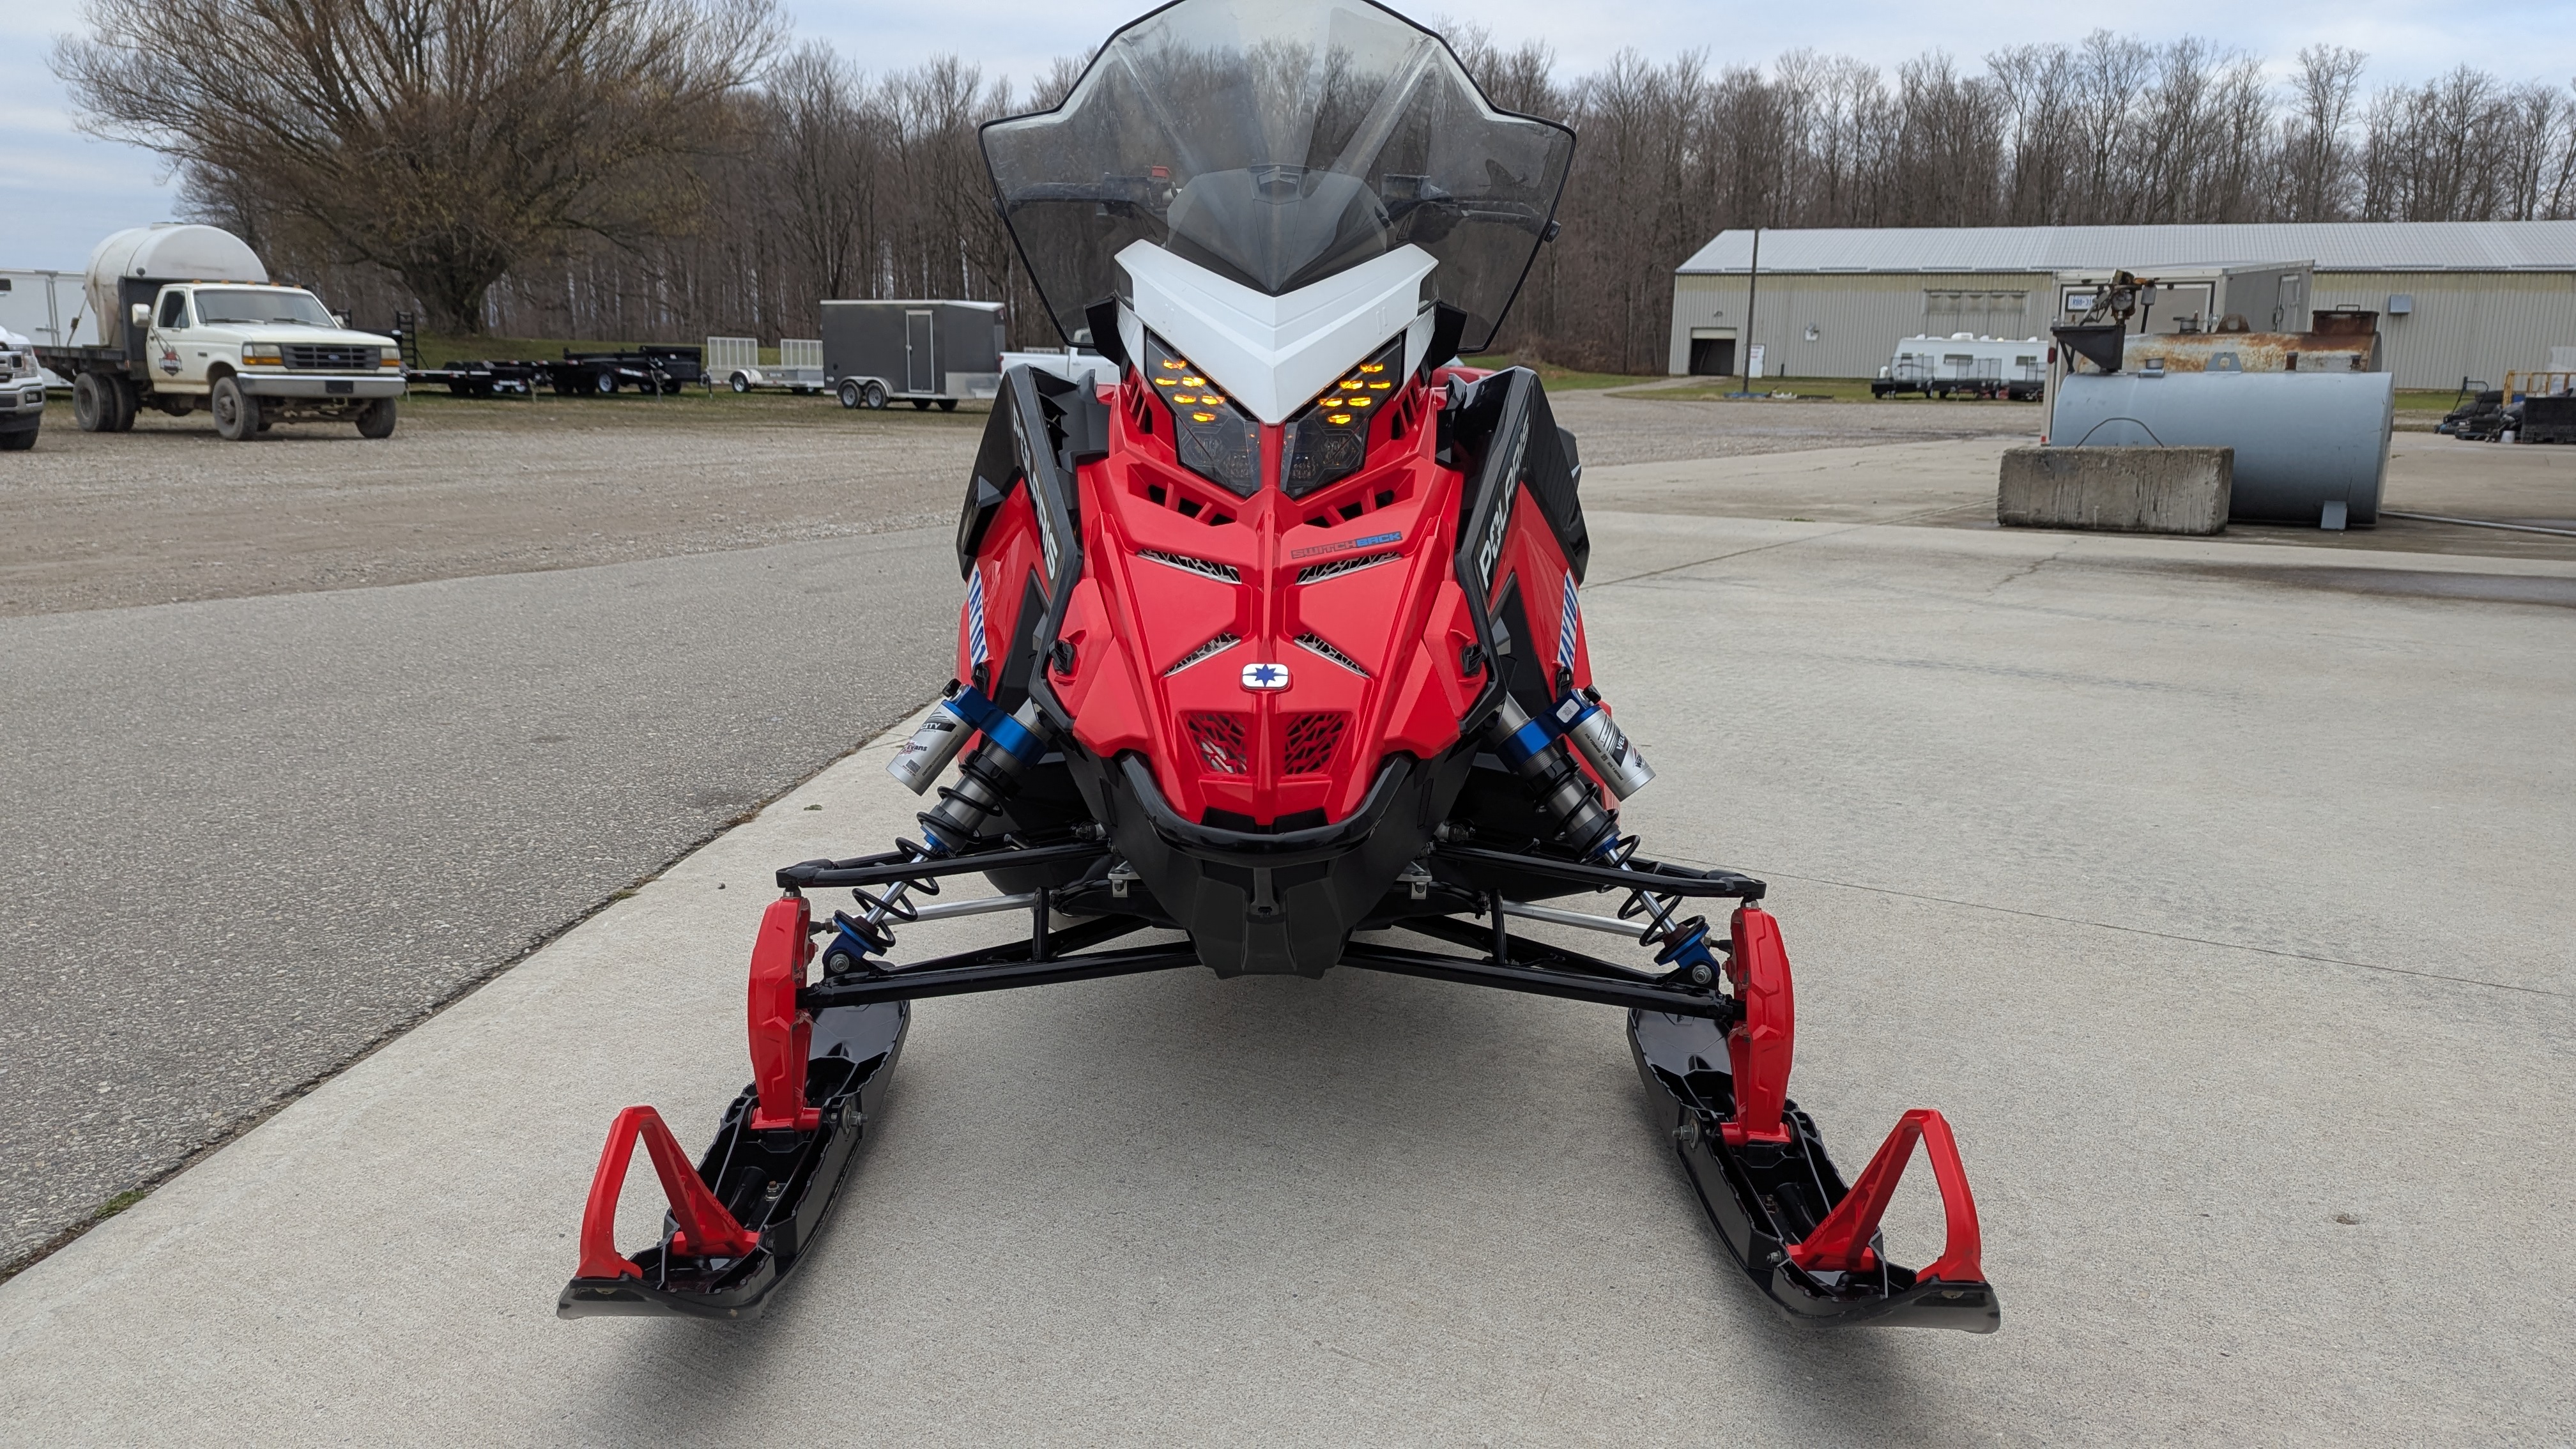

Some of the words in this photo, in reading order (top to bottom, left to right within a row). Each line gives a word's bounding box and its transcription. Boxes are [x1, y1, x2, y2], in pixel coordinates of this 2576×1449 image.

[1013, 400, 1058, 580] POLARIS
[1291, 531, 1403, 559] SWITCHBACK
[1479, 410, 1529, 591] POLARIS
